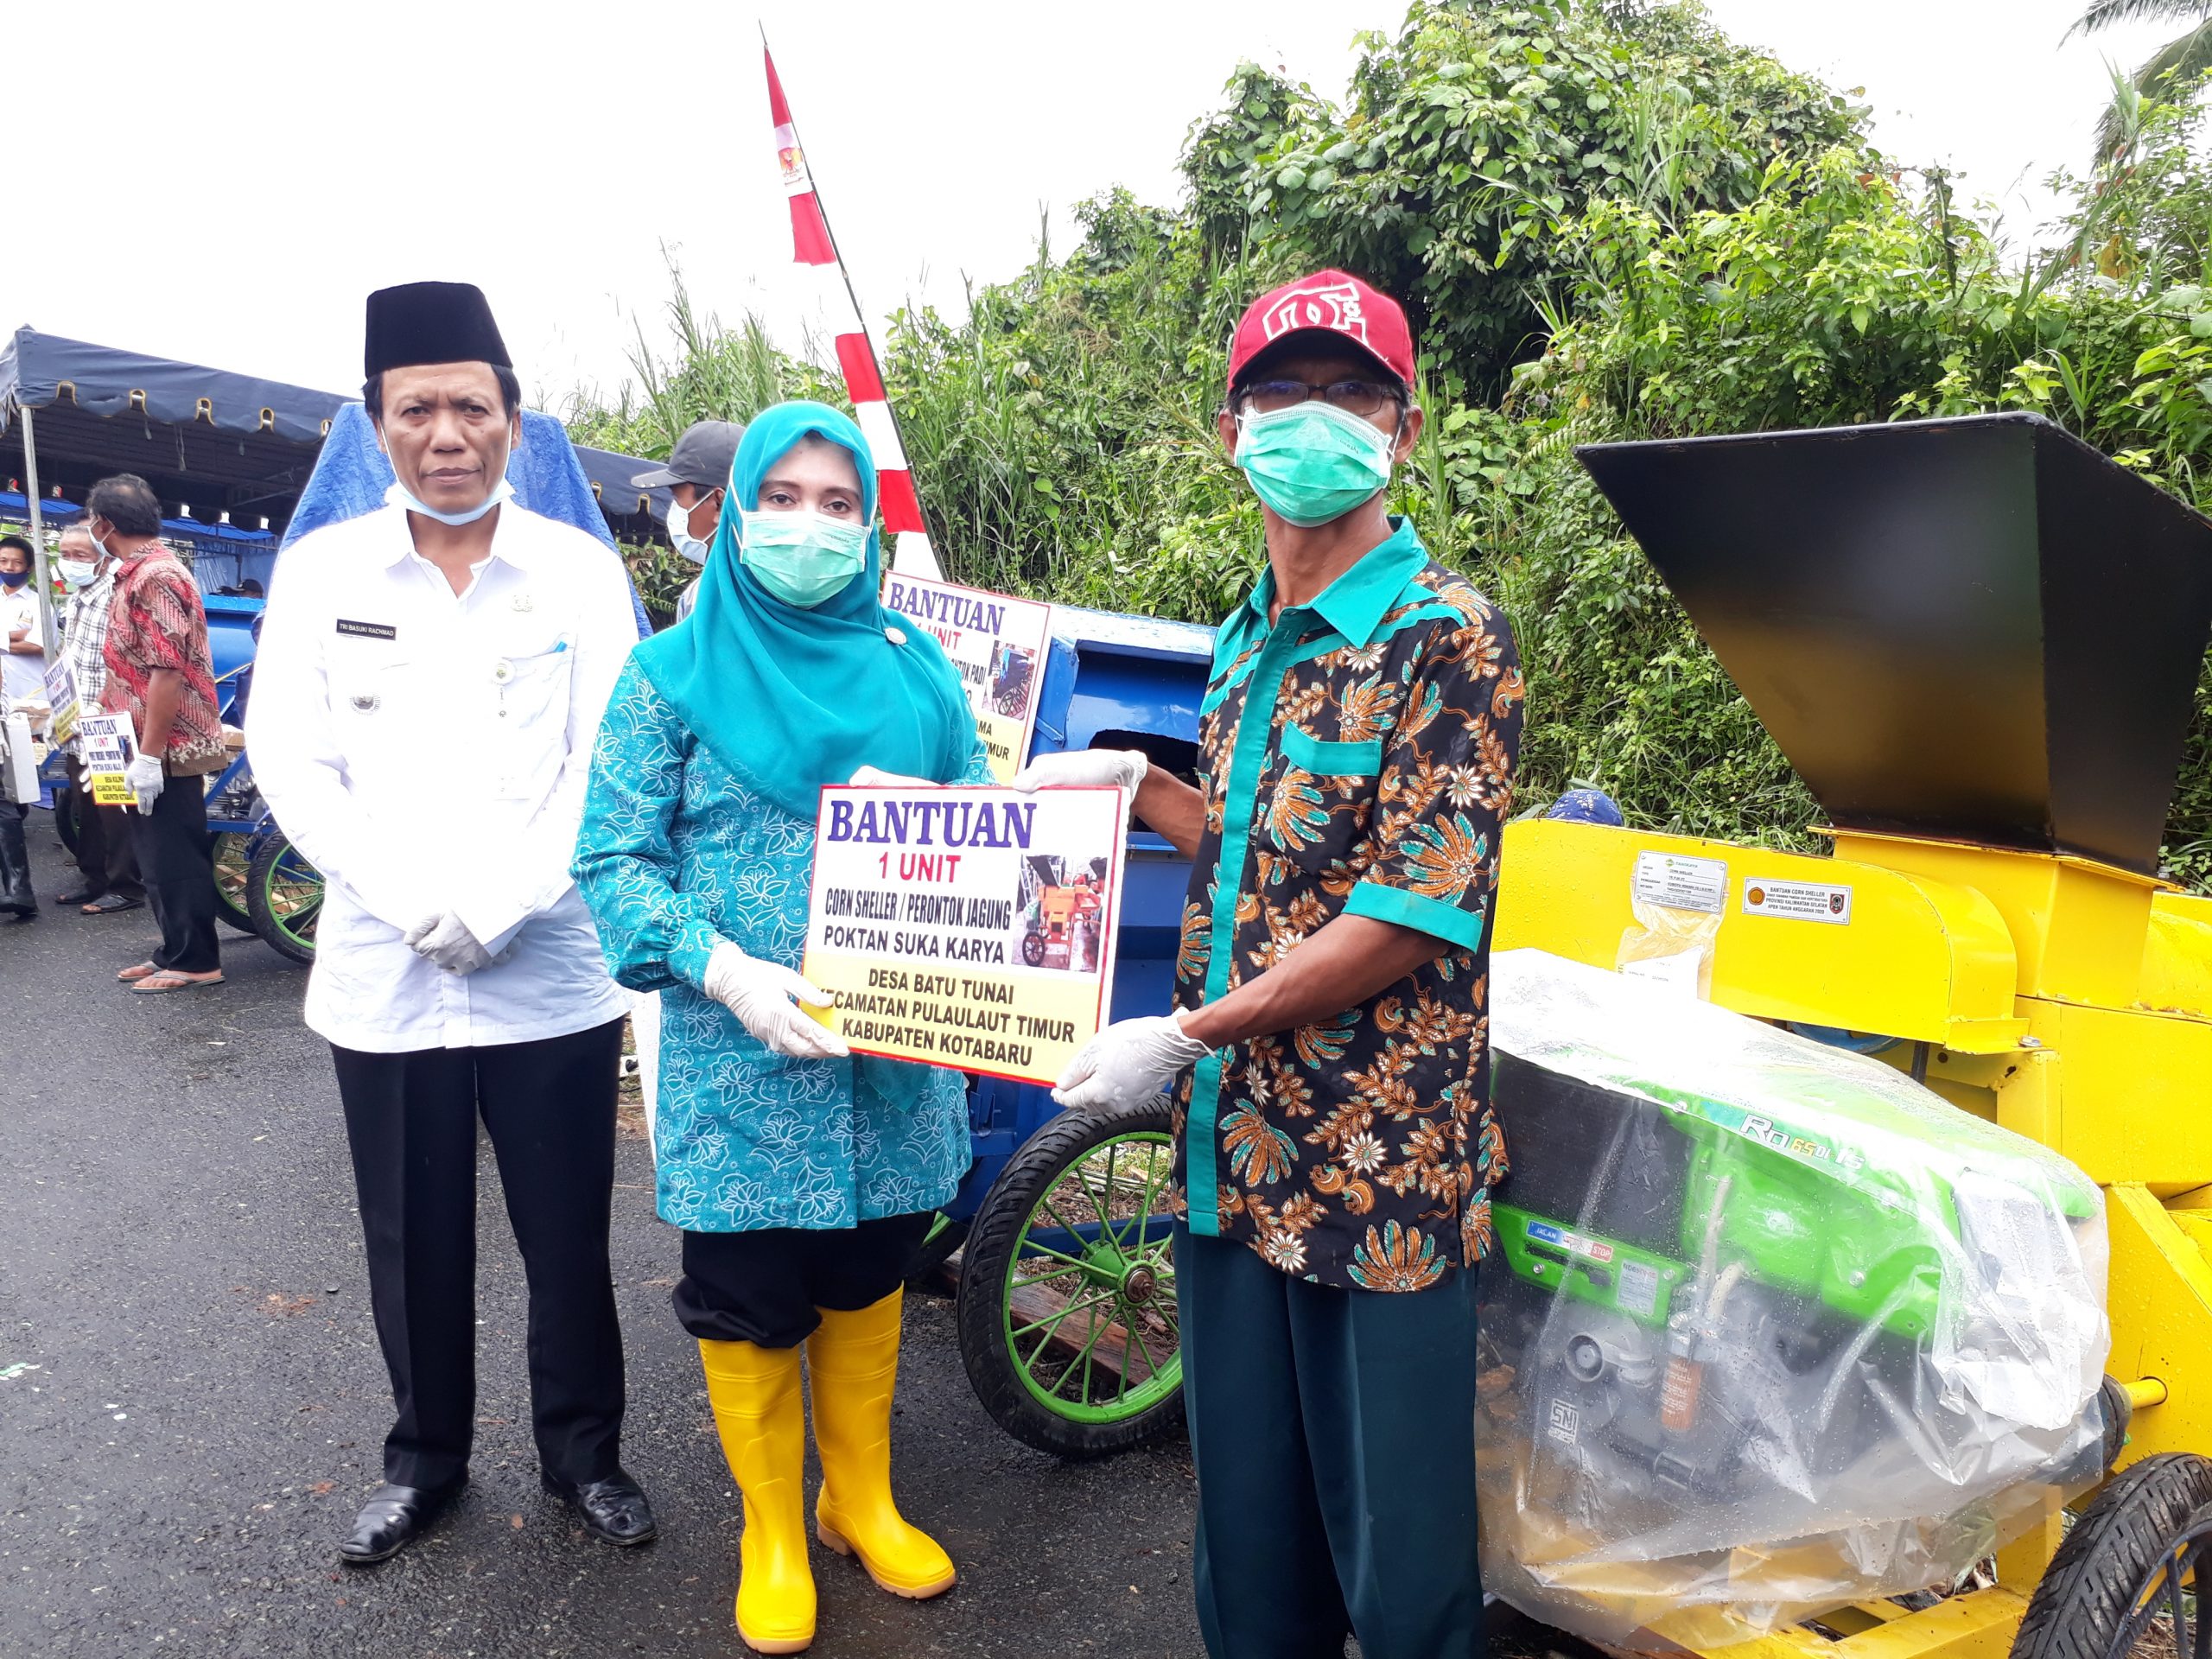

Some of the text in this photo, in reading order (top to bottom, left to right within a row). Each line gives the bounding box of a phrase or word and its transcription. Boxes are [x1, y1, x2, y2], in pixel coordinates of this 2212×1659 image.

[887, 582, 1006, 635] BANTUAN
[349, 624, 367, 632] BASUKI
[368, 627, 394, 637] RACHMAD
[969, 664, 987, 686] PADI
[81, 719, 118, 736] BANTUAN
[827, 800, 1037, 849] BANTUAN
[879, 851, 961, 883] 1 UNIT
[825, 887, 854, 917] CORN
[855, 890, 896, 921] SHELLER
[908, 893, 963, 927] PERONTOK
[965, 896, 1011, 931] JAGUNG
[824, 925, 1004, 964] POKTAN SUKA KARYA
[868, 969, 1014, 1005] DESA BATU TUNAI
[818, 988, 1075, 1043] CAMATAN PULAULAUT TIMUR
[842, 1018, 1033, 1066] KABUPATEN KOTABARU
[1592, 1245, 1611, 1256] STOP
